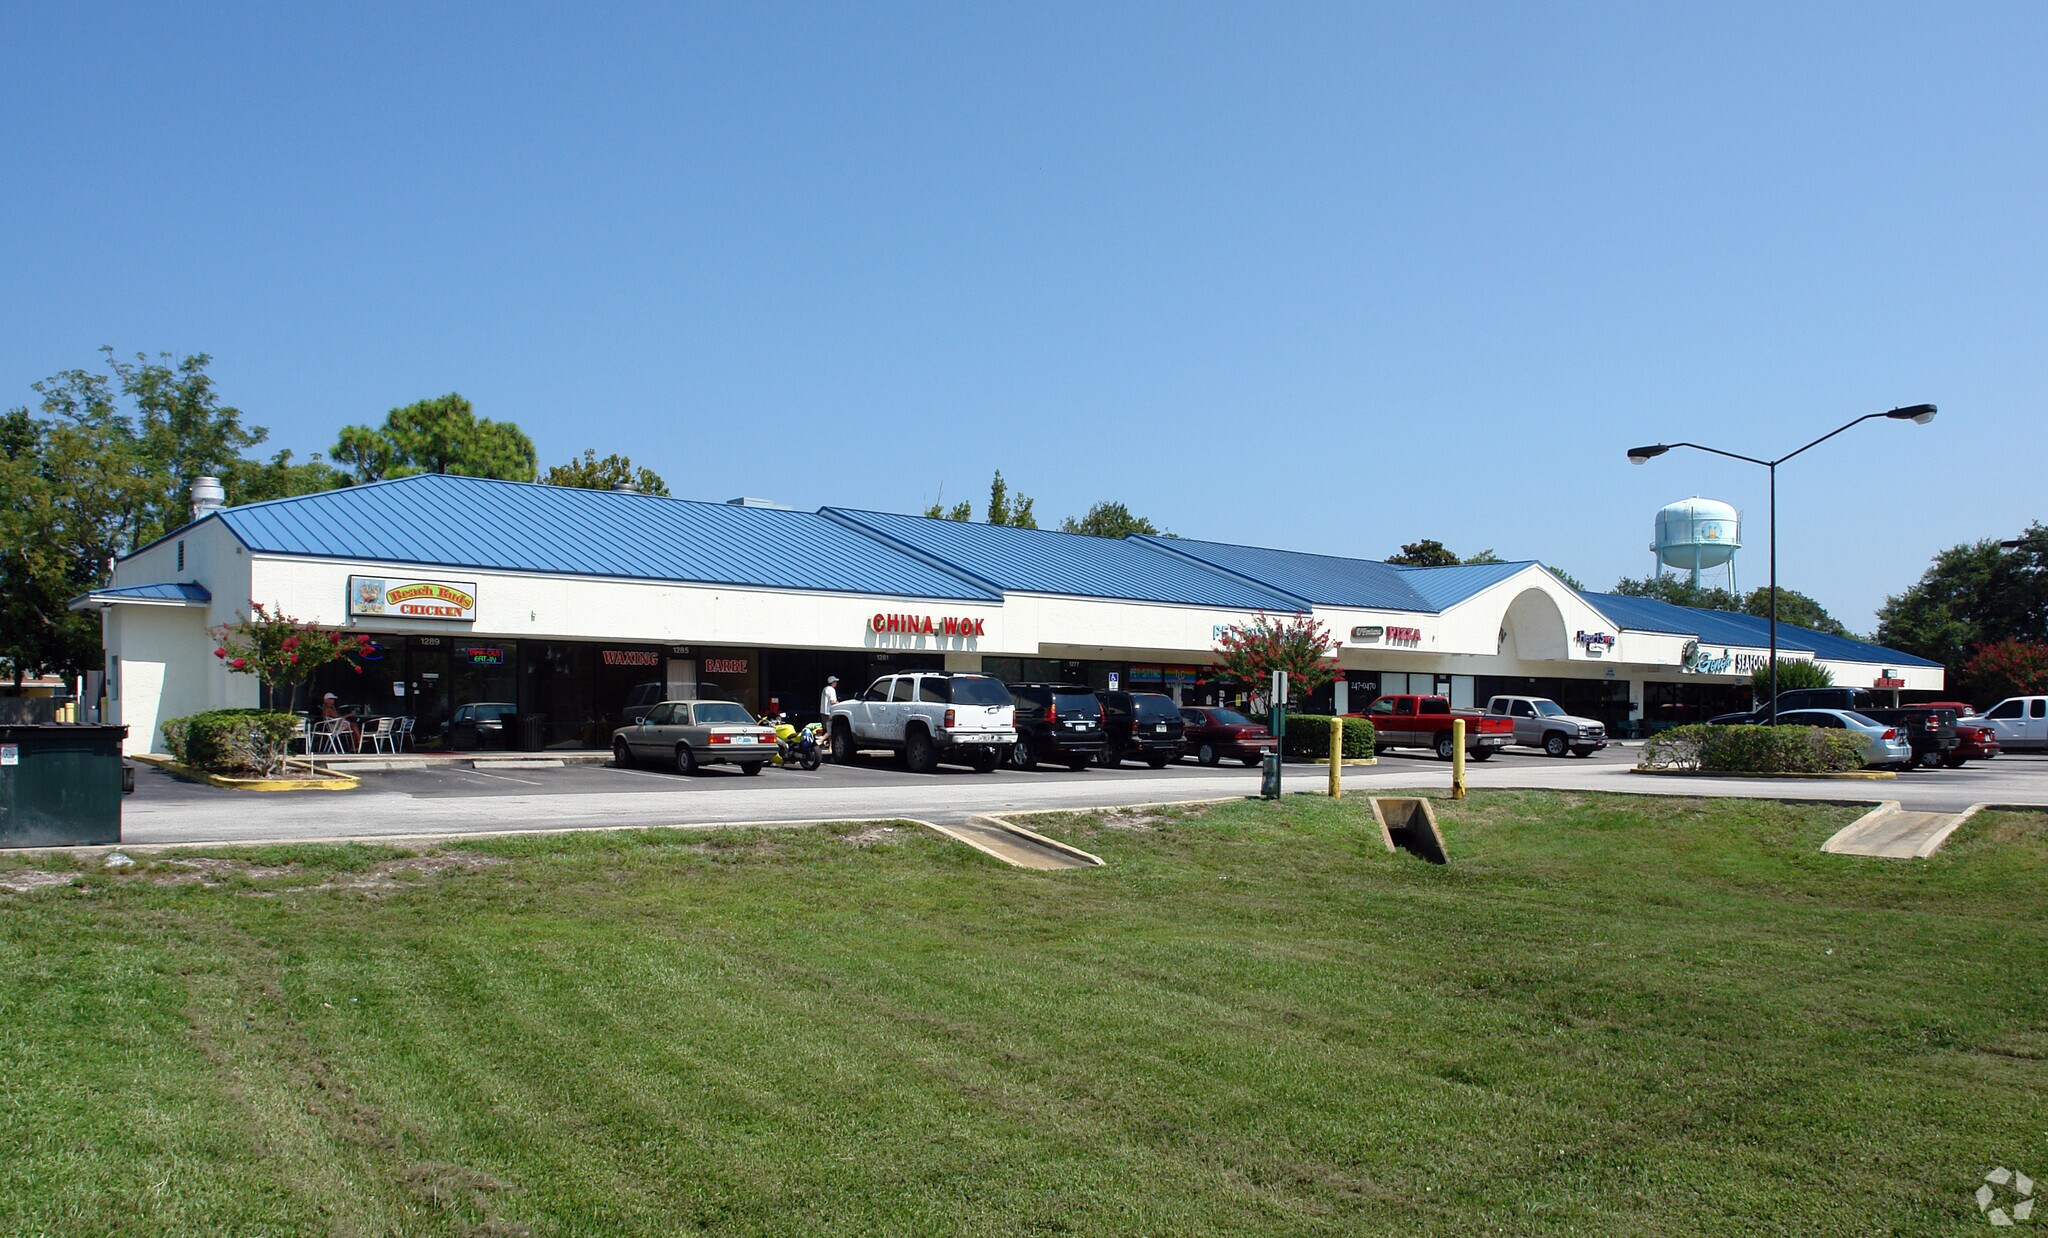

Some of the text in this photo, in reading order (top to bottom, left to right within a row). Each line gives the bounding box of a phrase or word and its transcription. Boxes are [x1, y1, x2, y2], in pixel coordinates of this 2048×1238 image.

[389, 585, 472, 607] Beach Buds
[400, 604, 463, 617] CHICKEN
[873, 613, 985, 636] CHINA WOK
[1386, 626, 1421, 641] PIZZA
[421, 638, 441, 646] 1289
[603, 651, 659, 666] WAXING
[705, 659, 748, 673] BARBE
[1350, 682, 1377, 691] 247-0470
